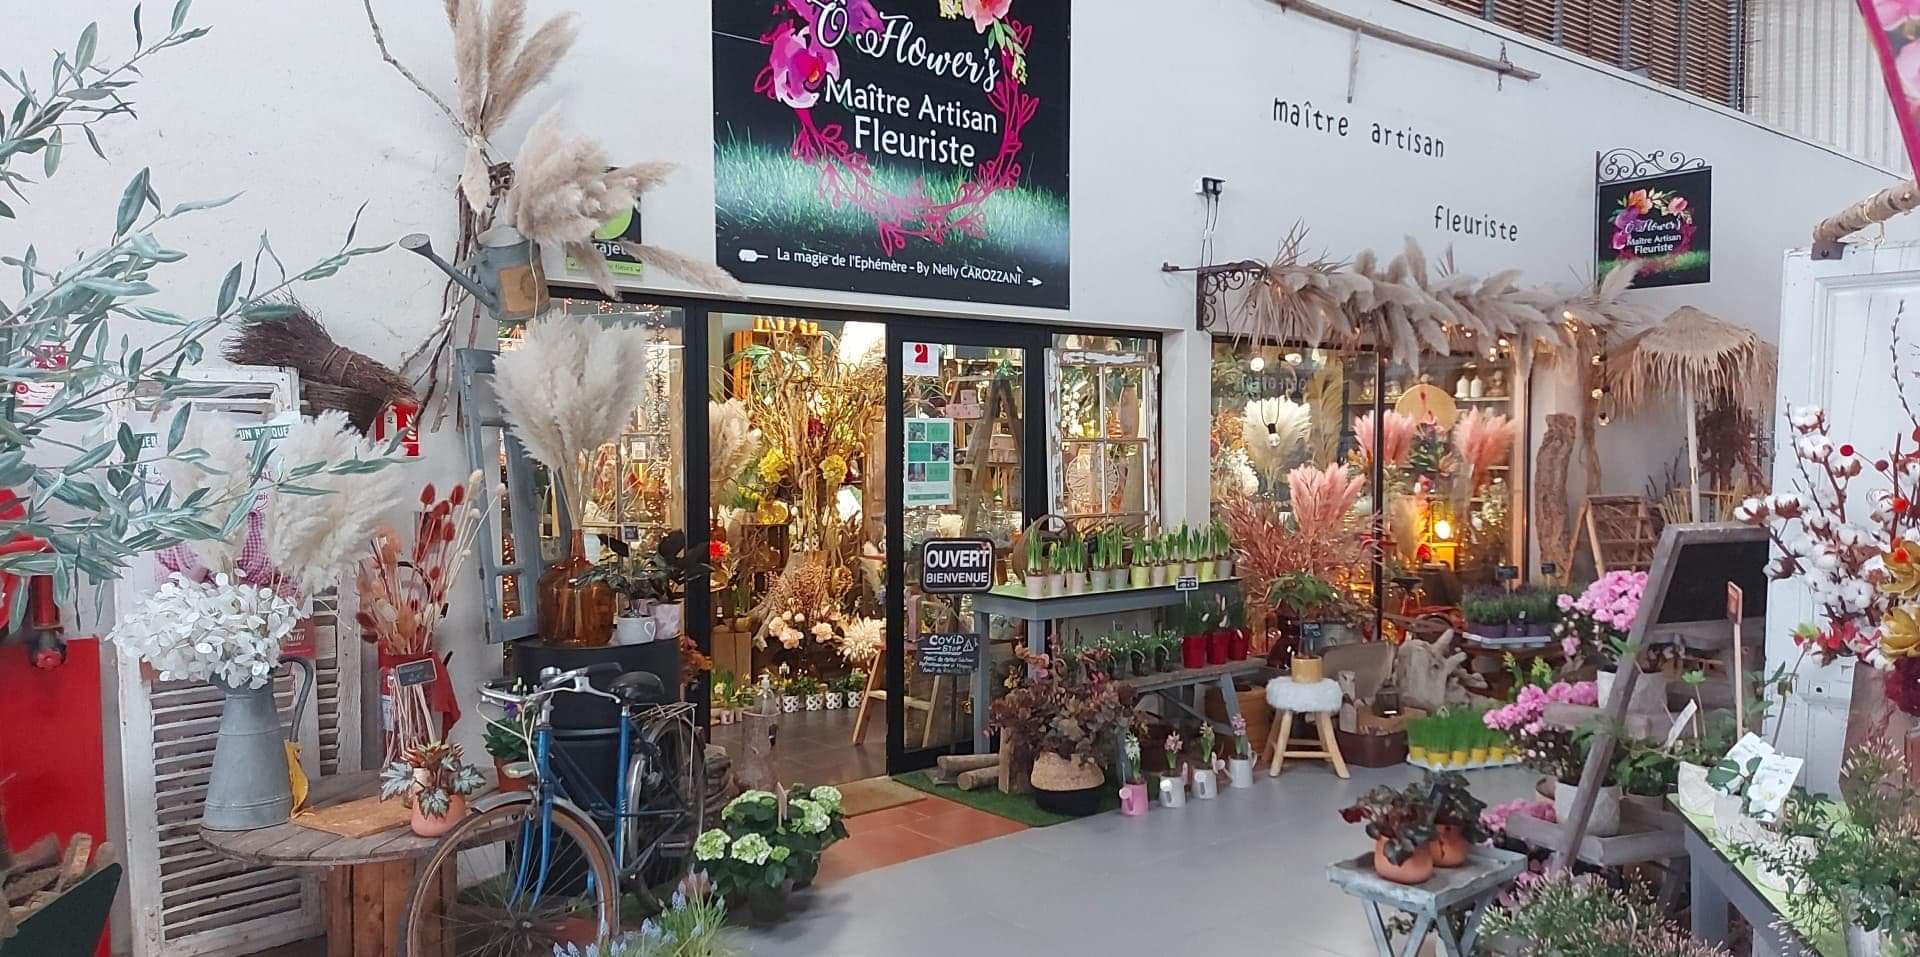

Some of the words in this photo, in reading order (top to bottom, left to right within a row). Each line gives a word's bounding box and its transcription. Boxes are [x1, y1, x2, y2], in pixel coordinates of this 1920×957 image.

[856, 10, 1000, 92] Flower's
[825, 74, 910, 118] Maître
[918, 94, 997, 134] Artisan
[854, 115, 976, 167] Fleuriste
[1273, 97, 1349, 137] maître
[1371, 122, 1445, 158] artisan
[1434, 204, 1518, 242] fleuriste
[1653, 234, 1682, 243] Artisan
[777, 247, 790, 261] La
[794, 251, 829, 267] magie
[831, 253, 846, 267] de
[916, 261, 930, 277] By
[932, 262, 959, 279] Nelly
[1634, 243, 1674, 255] Fleuriste
[926, 549, 990, 568] OUVERT
[925, 572, 989, 584] BIENVENUE
